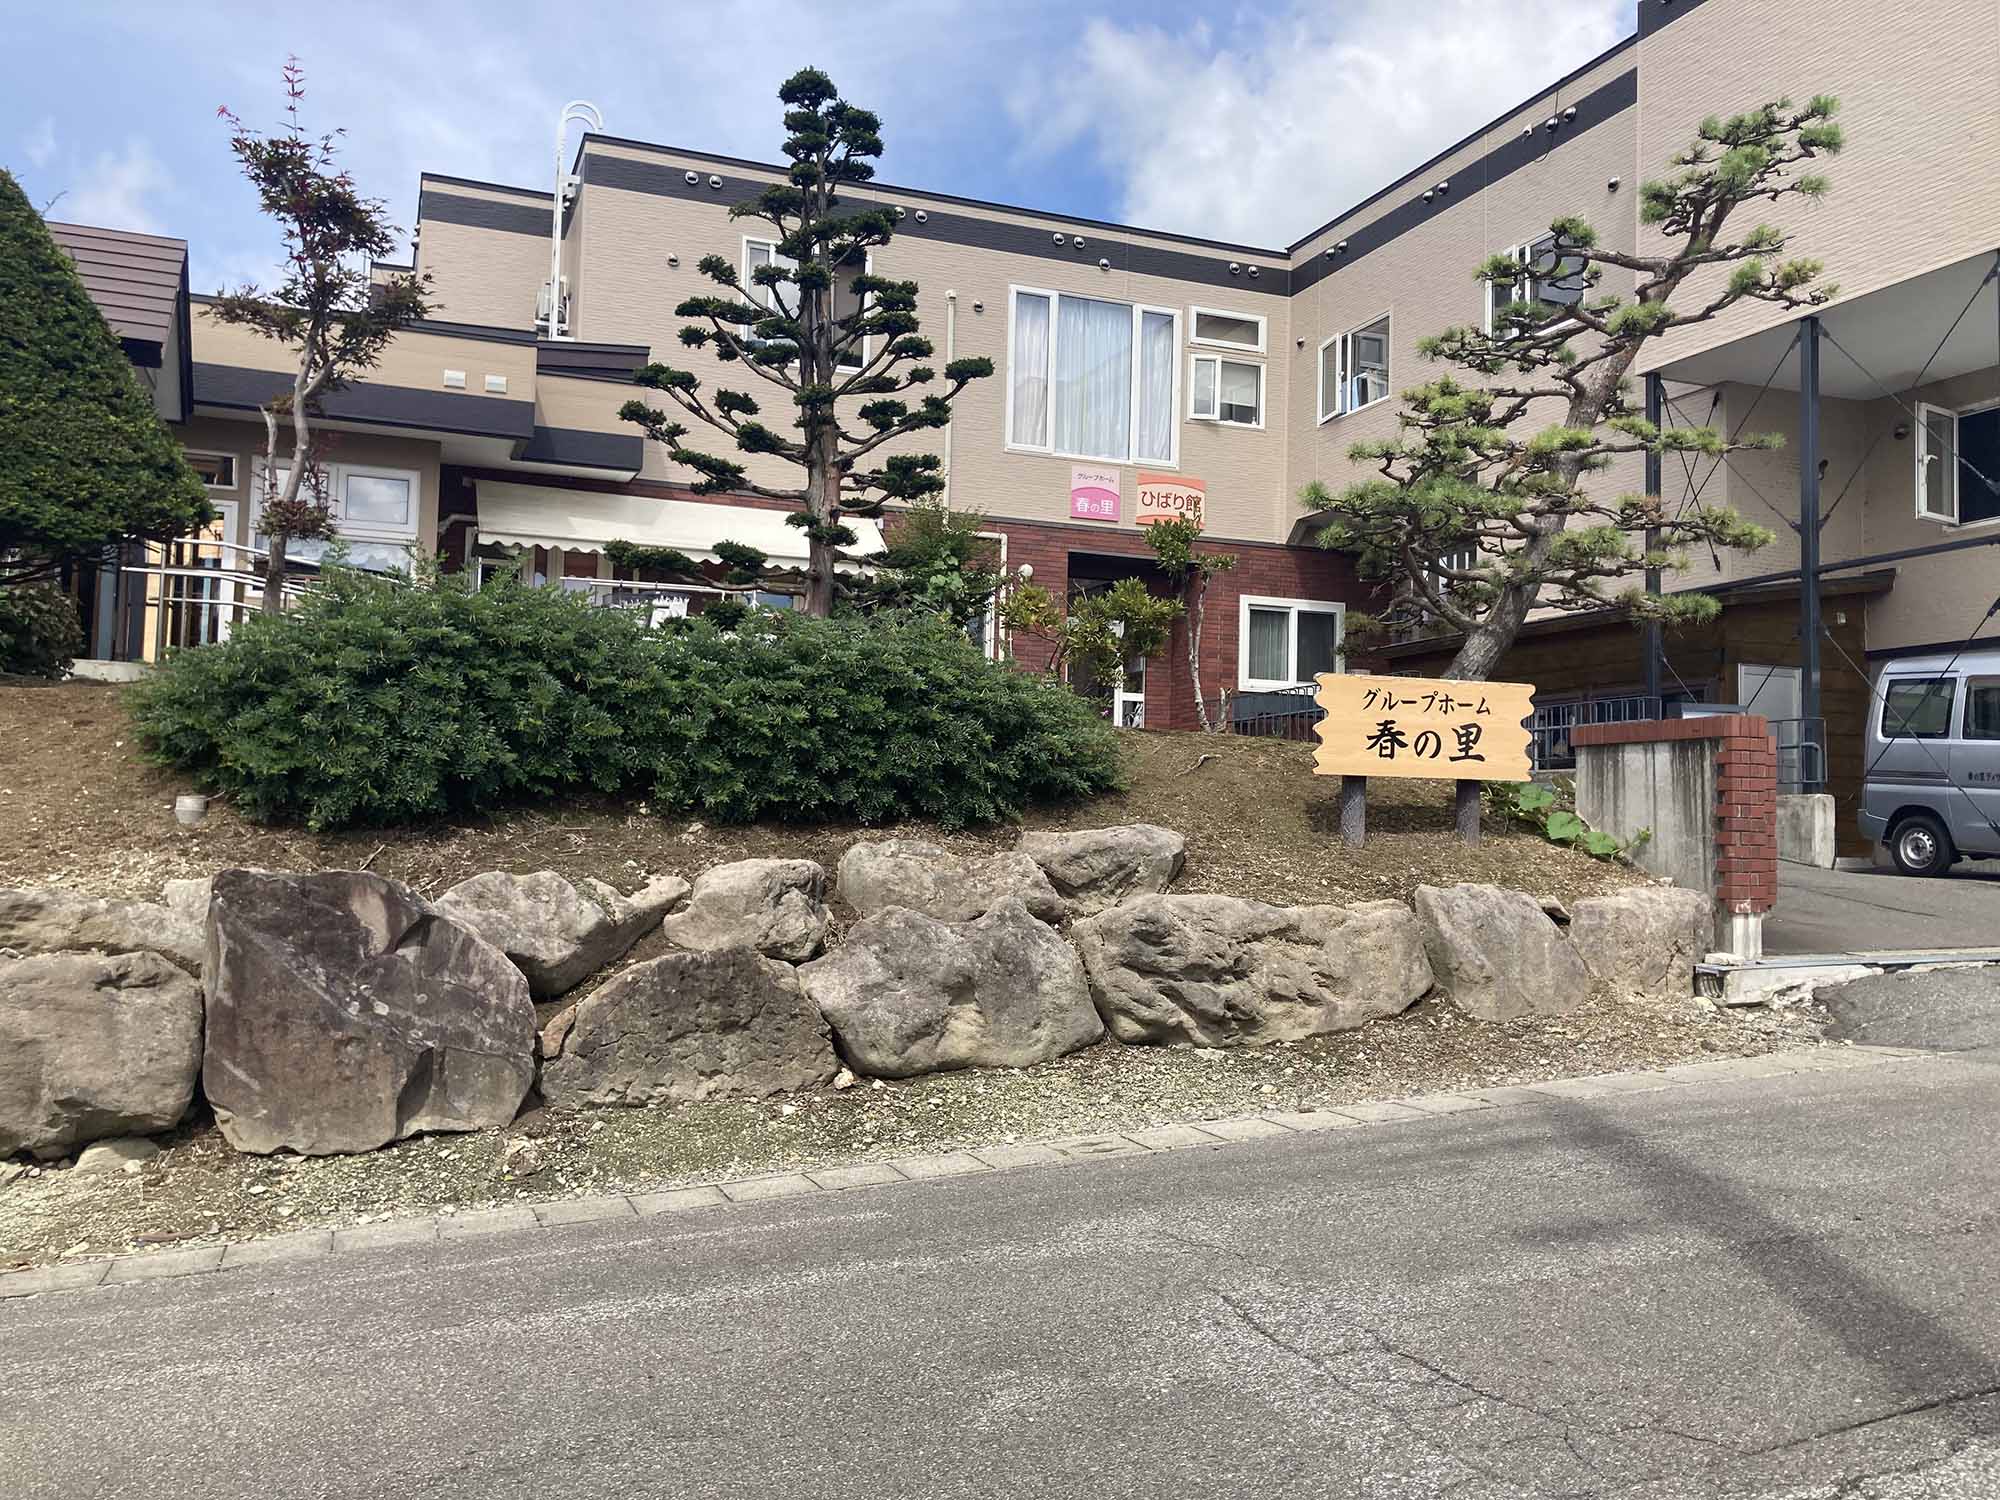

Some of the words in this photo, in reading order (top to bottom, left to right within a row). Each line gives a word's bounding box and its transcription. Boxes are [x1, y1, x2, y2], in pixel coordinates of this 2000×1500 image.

[1077, 498, 1113, 514] 春の里
[1141, 492, 1201, 512] ひばり館
[1362, 688, 1491, 715] グループホーム
[1366, 720, 1485, 762] 春の里
